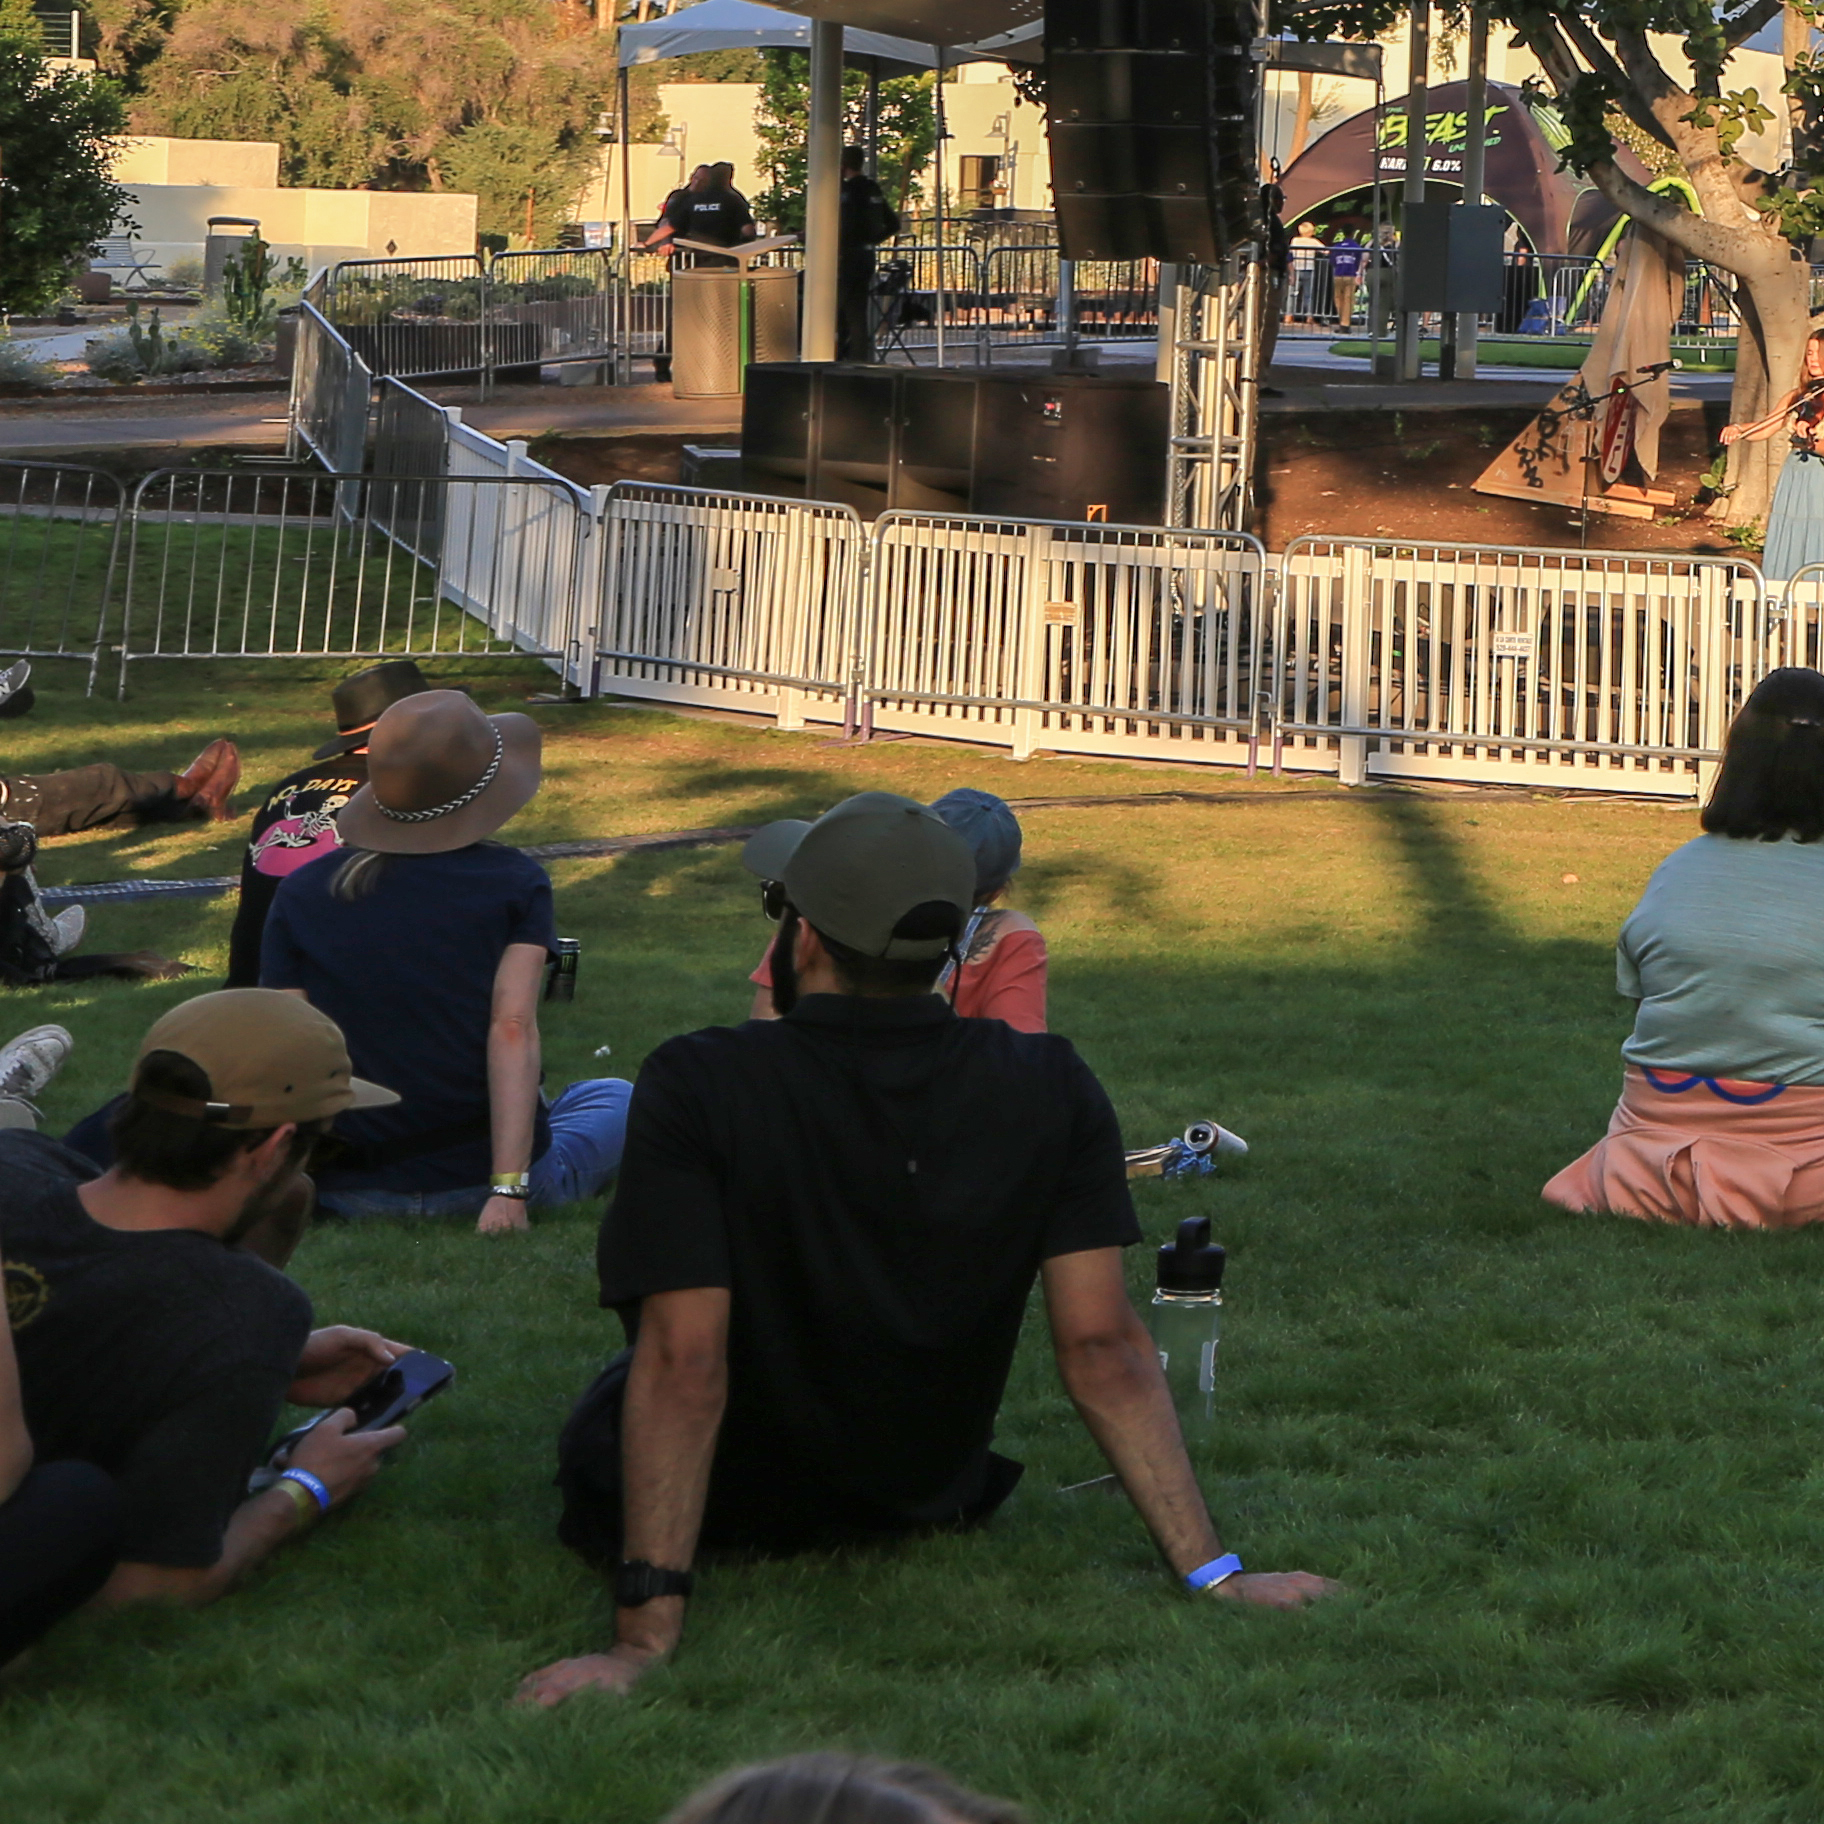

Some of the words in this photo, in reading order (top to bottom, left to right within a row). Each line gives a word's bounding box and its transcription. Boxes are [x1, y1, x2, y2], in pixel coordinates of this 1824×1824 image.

[693, 203, 721, 212] POLICE
[267, 785, 298, 812] NO
[302, 778, 359, 793] DAYS
